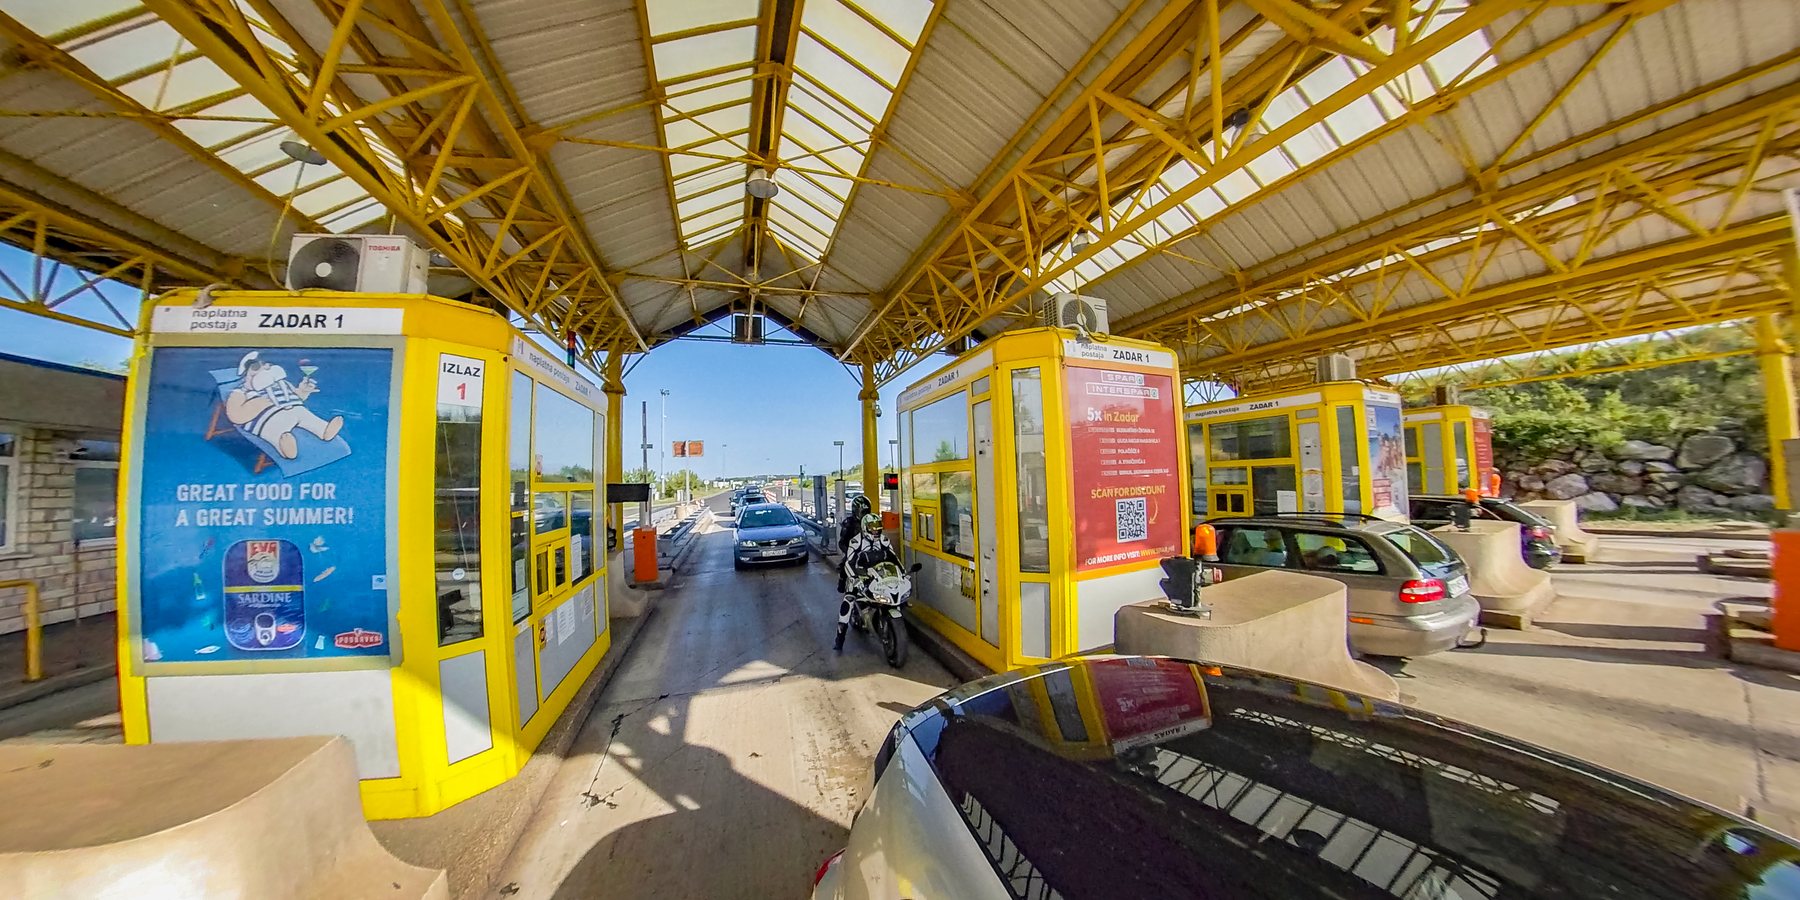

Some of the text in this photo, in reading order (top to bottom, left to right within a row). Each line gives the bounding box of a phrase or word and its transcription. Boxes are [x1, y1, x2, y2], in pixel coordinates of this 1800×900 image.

[192, 308, 248, 320] naplatna
[258, 313, 344, 329] ZADAR 1
[190, 319, 238, 332] postaja
[1081, 351, 1104, 360] postaja
[1113, 349, 1150, 363] ZADAR 1
[443, 362, 481, 378] IZLAZ
[938, 372, 955, 386] ZADAR
[1107, 373, 1136, 383] SPAR
[456, 382, 467, 401] 1
[1091, 385, 1151, 397] INTERSPAR
[1249, 402, 1273, 411] ZADAR
[1087, 406, 1140, 423] 5x in Zadar
[177, 482, 337, 502] GREAT FOOD FOR
[1091, 485, 1166, 499] SCAN FOR DISCOUNT
[175, 506, 354, 528] A GREAT SUMMER!
[251, 541, 278, 555] EVA
[1097, 555, 1113, 565] MORE
[1113, 552, 1127, 562] INFO
[238, 591, 293, 604] SARDINE
